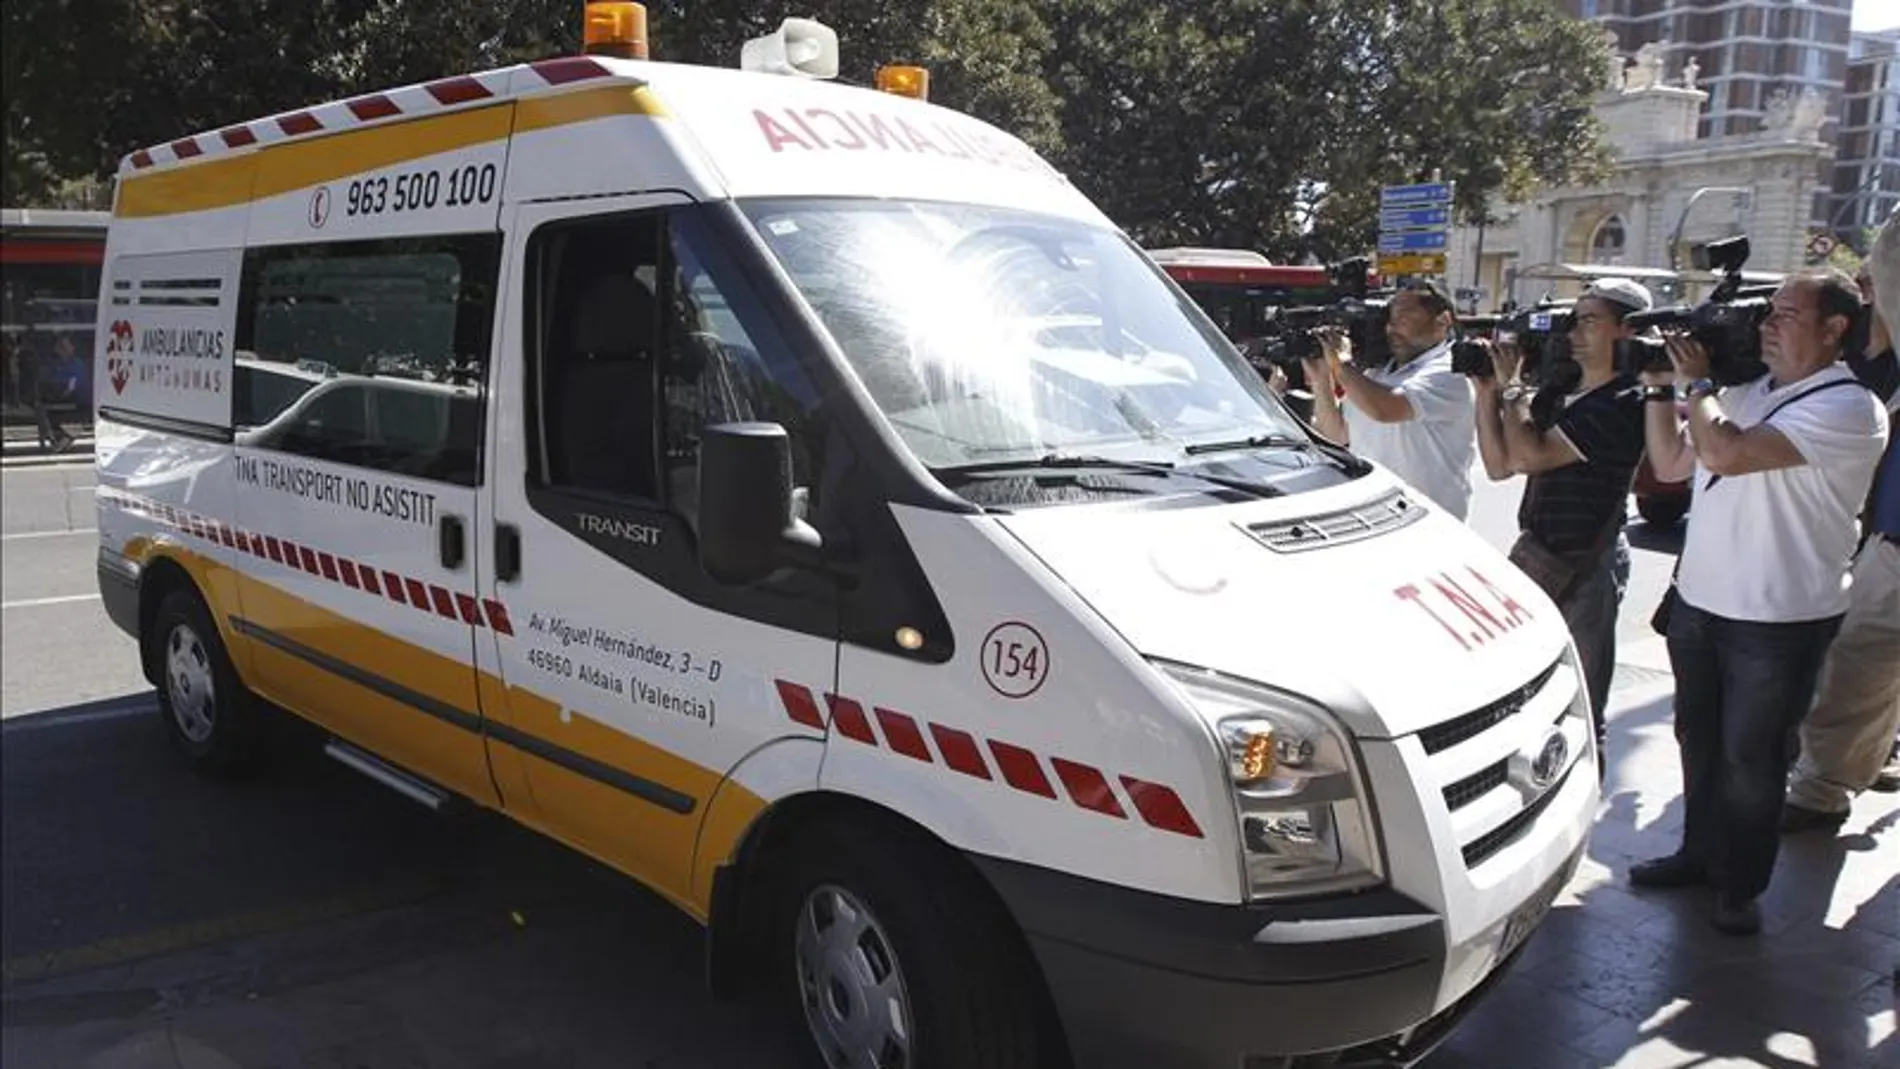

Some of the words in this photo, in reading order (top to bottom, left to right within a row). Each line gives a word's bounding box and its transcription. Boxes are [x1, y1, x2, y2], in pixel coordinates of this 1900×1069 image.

[346, 177, 388, 216] 963
[393, 170, 440, 212] 500
[445, 163, 496, 207] 100
[140, 326, 225, 359] AMBULANCIAS
[234, 455, 259, 485] TNA
[262, 460, 343, 504] TRANSPORT
[346, 479, 369, 511] NO
[372, 484, 436, 526] ASISTIT
[576, 512, 662, 545] TRANSIT
[548, 616, 593, 647] Miguel
[993, 640, 1038, 680] 154
[527, 648, 573, 678] 46960
[578, 664, 624, 695] Aldaia
[630, 676, 716, 729] (Valencia)
